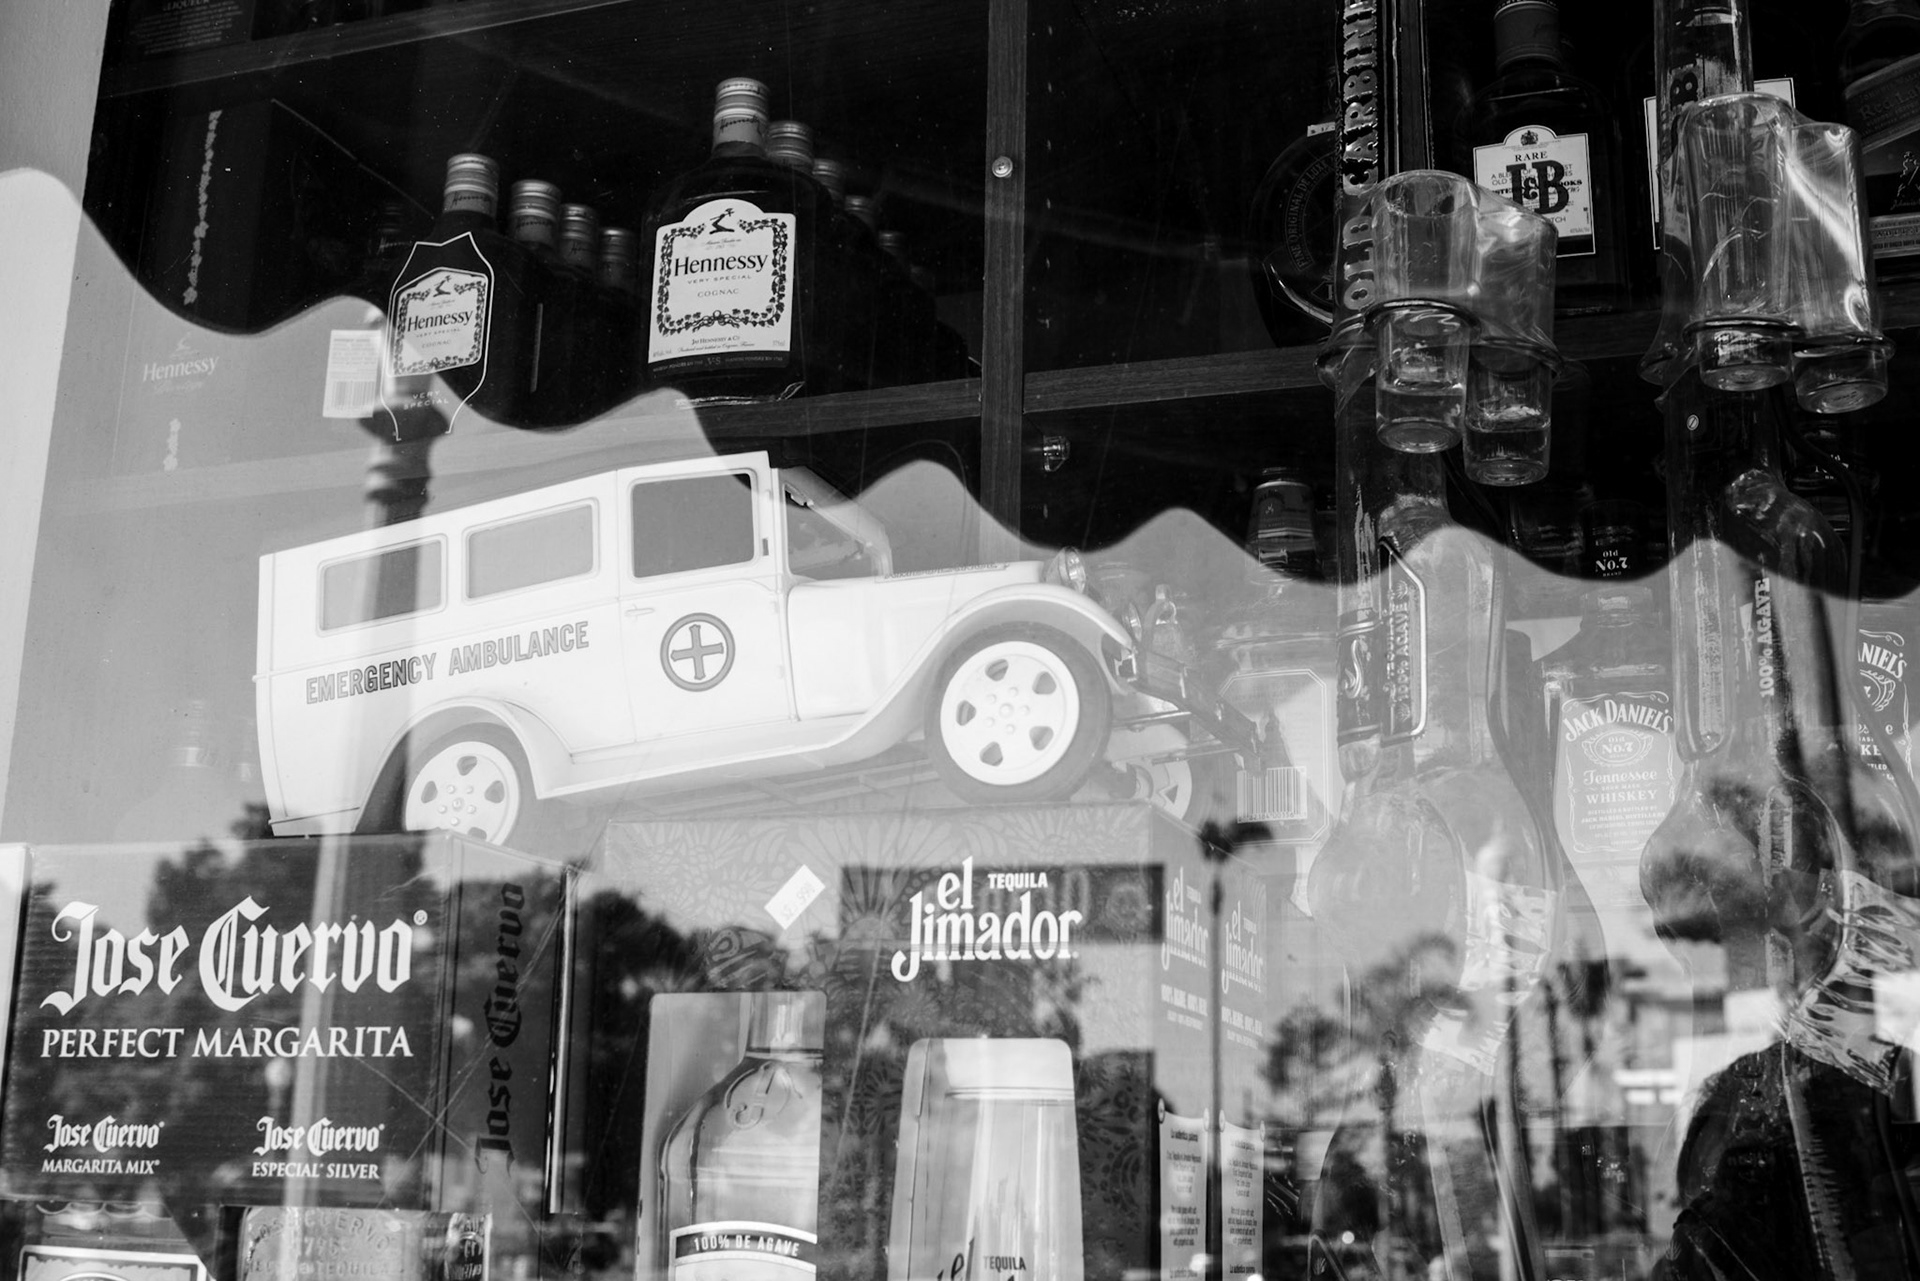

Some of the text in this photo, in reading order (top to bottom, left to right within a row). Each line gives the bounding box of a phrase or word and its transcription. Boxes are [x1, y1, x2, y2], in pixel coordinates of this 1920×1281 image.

[1515, 150, 1549, 163] RARE
[674, 254, 769, 277] Hennessy
[1342, 216, 1375, 310] OLD
[697, 288, 740, 298] COGNAC
[407, 310, 475, 333] Hennessy
[143, 355, 219, 383] Hennessy
[403, 398, 450, 412] SPECIAL
[412, 389, 441, 400] VERY
[1595, 556, 1628, 573] No.7
[1602, 549, 1619, 558] Old
[1395, 602, 1410, 657] AGAVE
[1754, 577, 1775, 698] 100% AGAVE
[306, 621, 590, 706] EMERGENCY AMBULANCE
[1563, 699, 1673, 742] JACK DANIEL'S
[1583, 769, 1658, 786] Tennessee
[1586, 789, 1658, 804] WHISKEY
[937, 856, 975, 911] el
[988, 871, 1049, 892] TEQUILA
[1172, 866, 1185, 913] el
[890, 890, 1083, 982] Jimador
[40, 895, 414, 1016] Jose Cuervo
[475, 881, 527, 1177] Jose Cuervo
[40, 1026, 414, 1059] PERFECT MARGARITA
[43, 1113, 160, 1154] Jose Cuervo
[252, 1115, 380, 1156] Jose Cuervo
[41, 1159, 120, 1175] MARGARITA
[252, 1161, 381, 1180] ESPECIAL SILVER
[693, 1234, 801, 1257] 100% DE AGAVE
[983, 1255, 1027, 1273] TEQUILA
